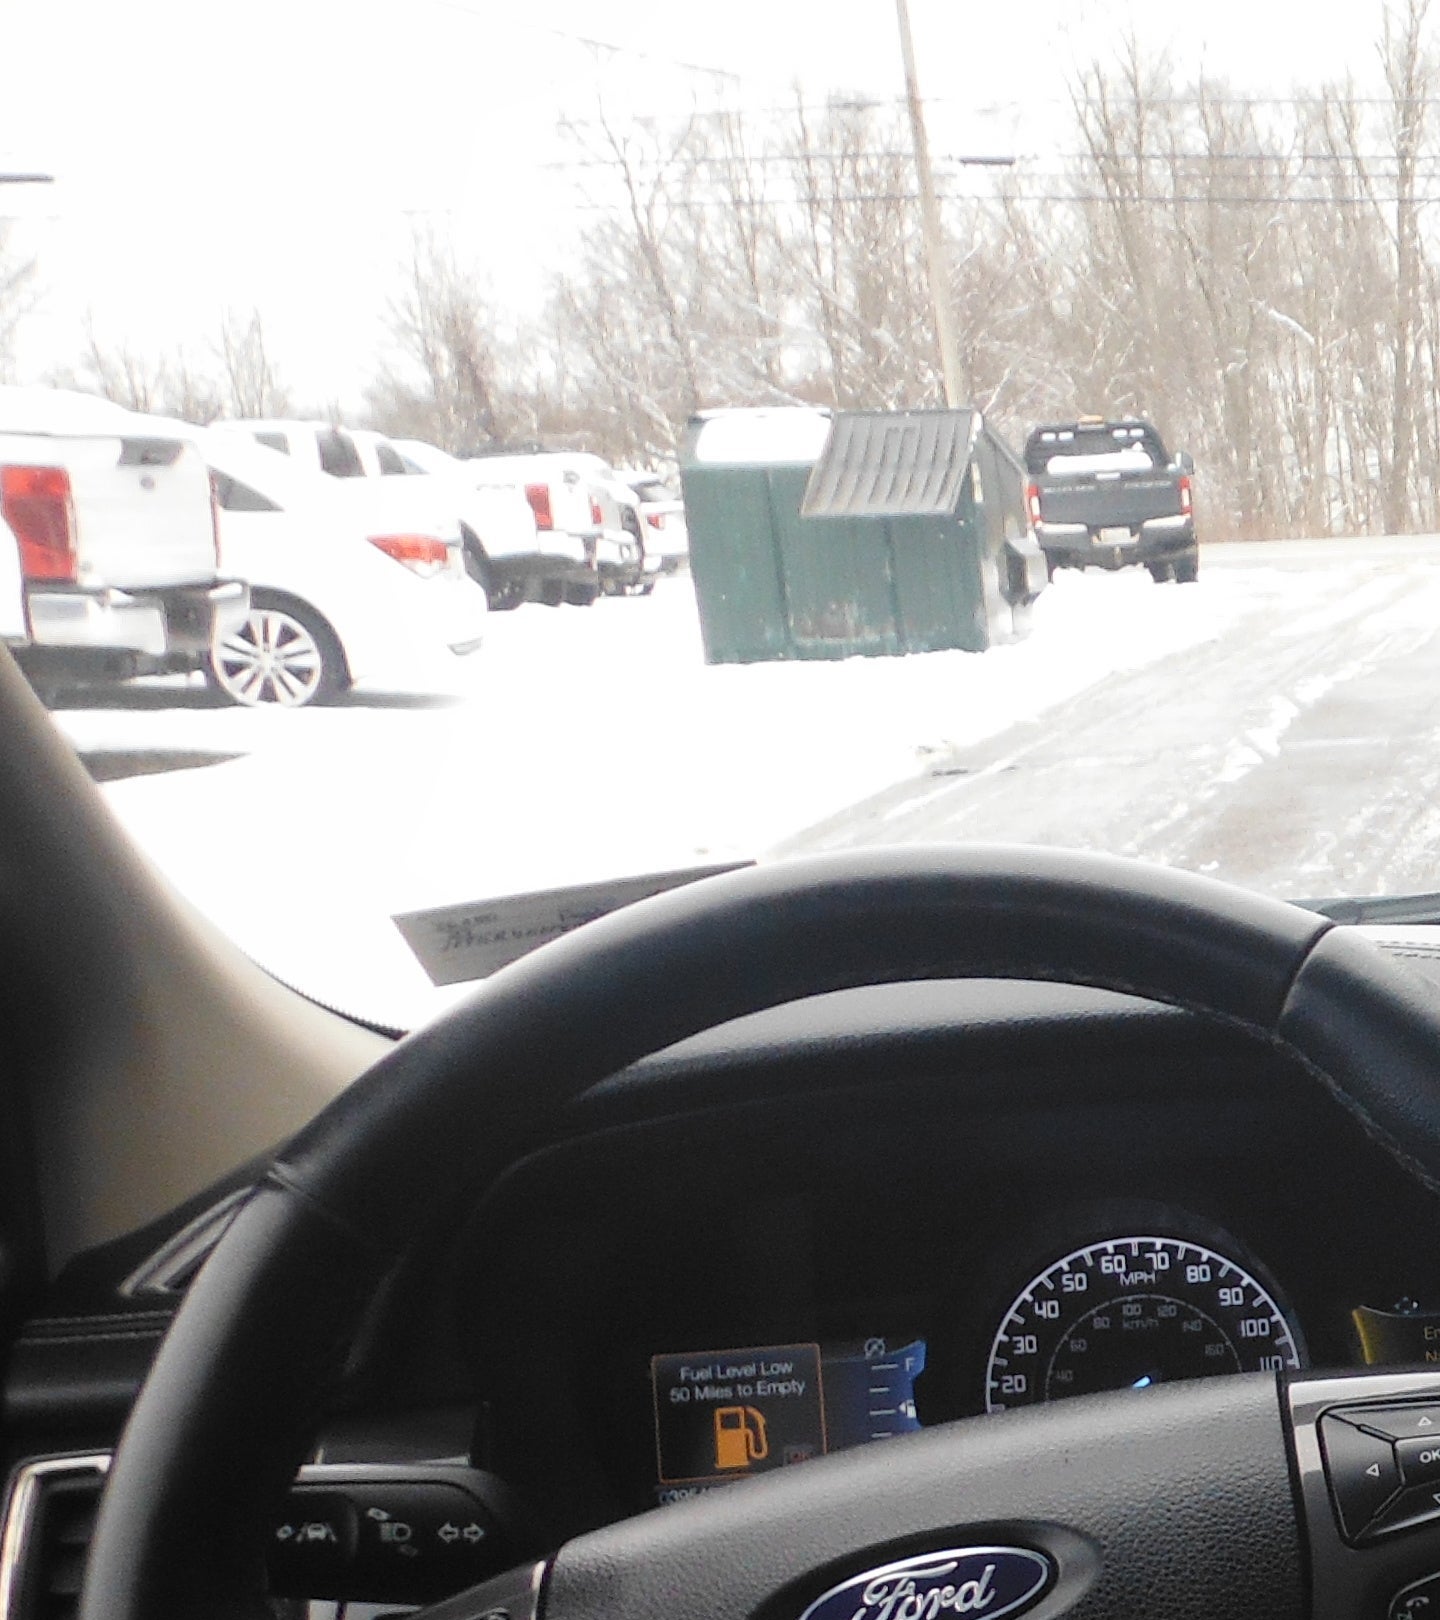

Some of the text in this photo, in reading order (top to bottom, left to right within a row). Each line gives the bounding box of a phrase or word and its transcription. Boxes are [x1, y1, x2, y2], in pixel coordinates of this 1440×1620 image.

[1100, 1255, 1126, 1274] 60
[1144, 1252, 1170, 1271] 70
[1061, 1273, 1088, 1293] 50
[1119, 1272, 1156, 1287] MPH
[1186, 1265, 1211, 1284] 80
[1218, 1287, 1244, 1306] 90
[1034, 1300, 1060, 1319] 40
[1240, 1318, 1270, 1337] 100
[1012, 1335, 1037, 1354] 30
[680, 1361, 793, 1381] Fuel Level Low
[905, 1357, 916, 1371] F
[670, 1380, 806, 1402] 50 Miles to Empty
[1002, 1374, 1027, 1393] 20
